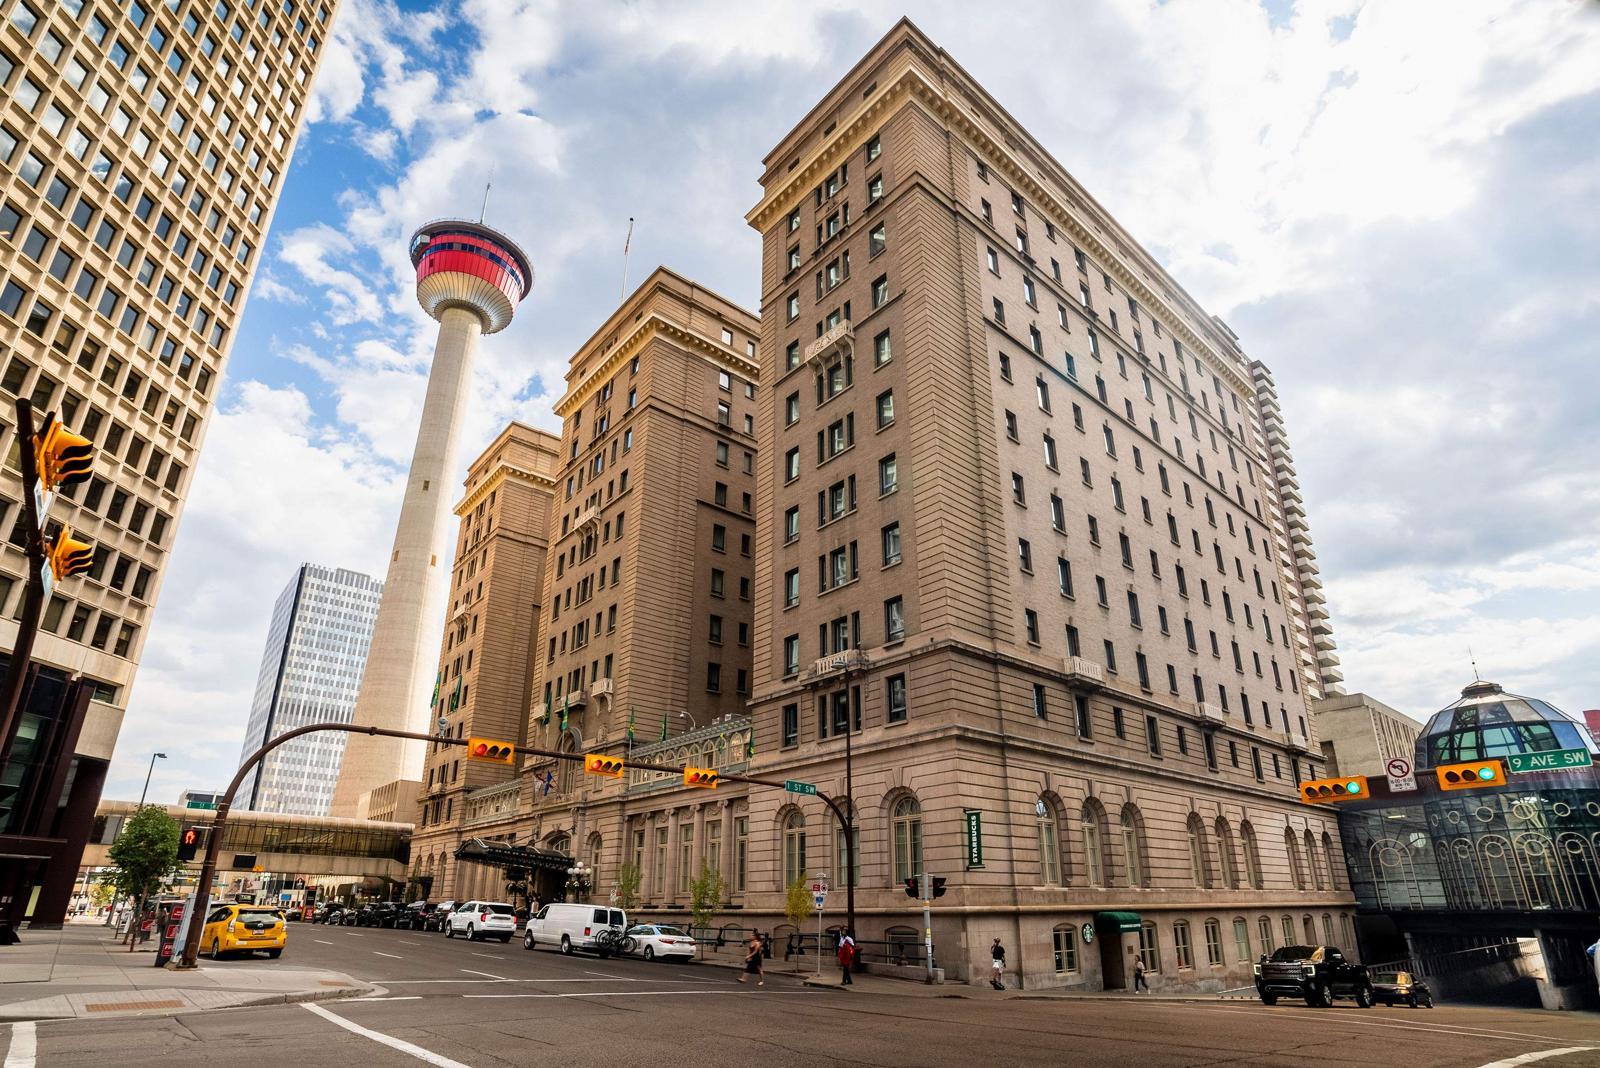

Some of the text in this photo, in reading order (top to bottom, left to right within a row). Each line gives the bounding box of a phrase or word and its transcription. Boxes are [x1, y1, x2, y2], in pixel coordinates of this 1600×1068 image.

[1512, 751, 1585, 768] 9 AVE SW
[805, 785, 815, 793] SW
[970, 815, 978, 863] STARBUCKS
